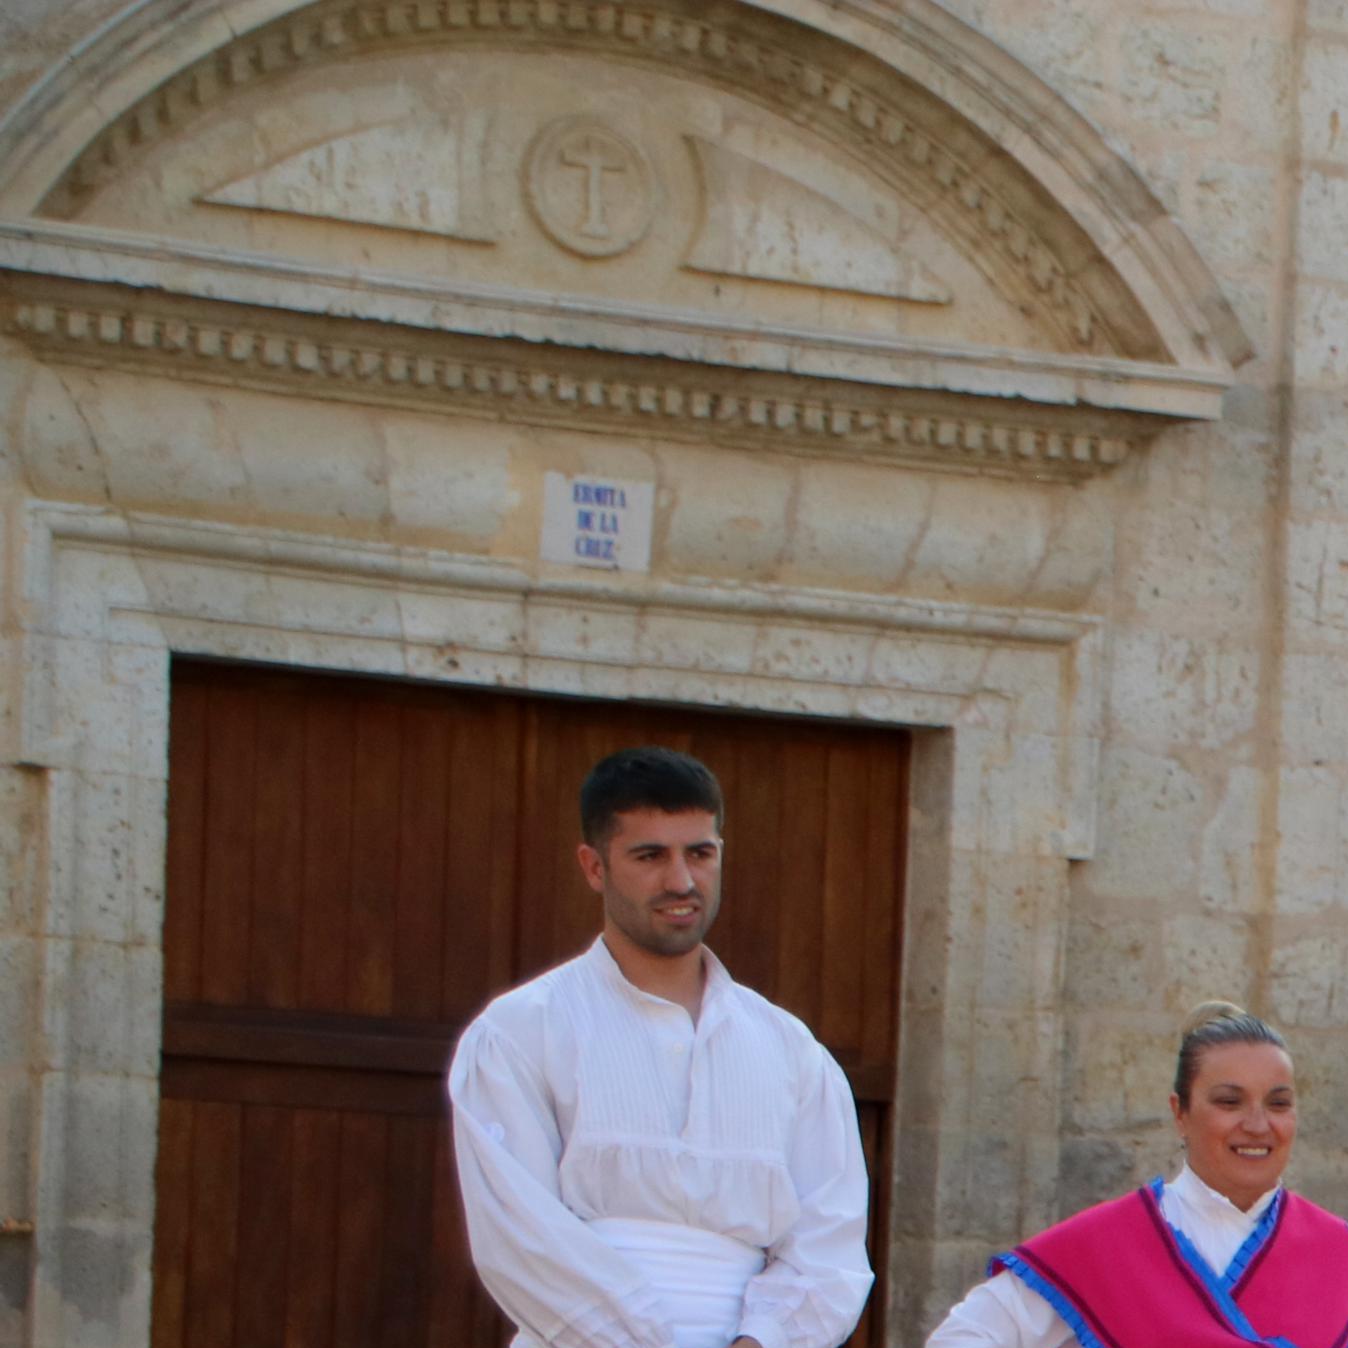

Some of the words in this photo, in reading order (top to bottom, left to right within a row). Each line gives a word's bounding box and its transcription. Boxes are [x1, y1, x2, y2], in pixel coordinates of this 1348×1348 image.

[574, 483, 626, 508] ERMITA
[578, 509, 595, 531] DE
[600, 511, 619, 534] LA
[575, 535, 616, 559] CRUZ
